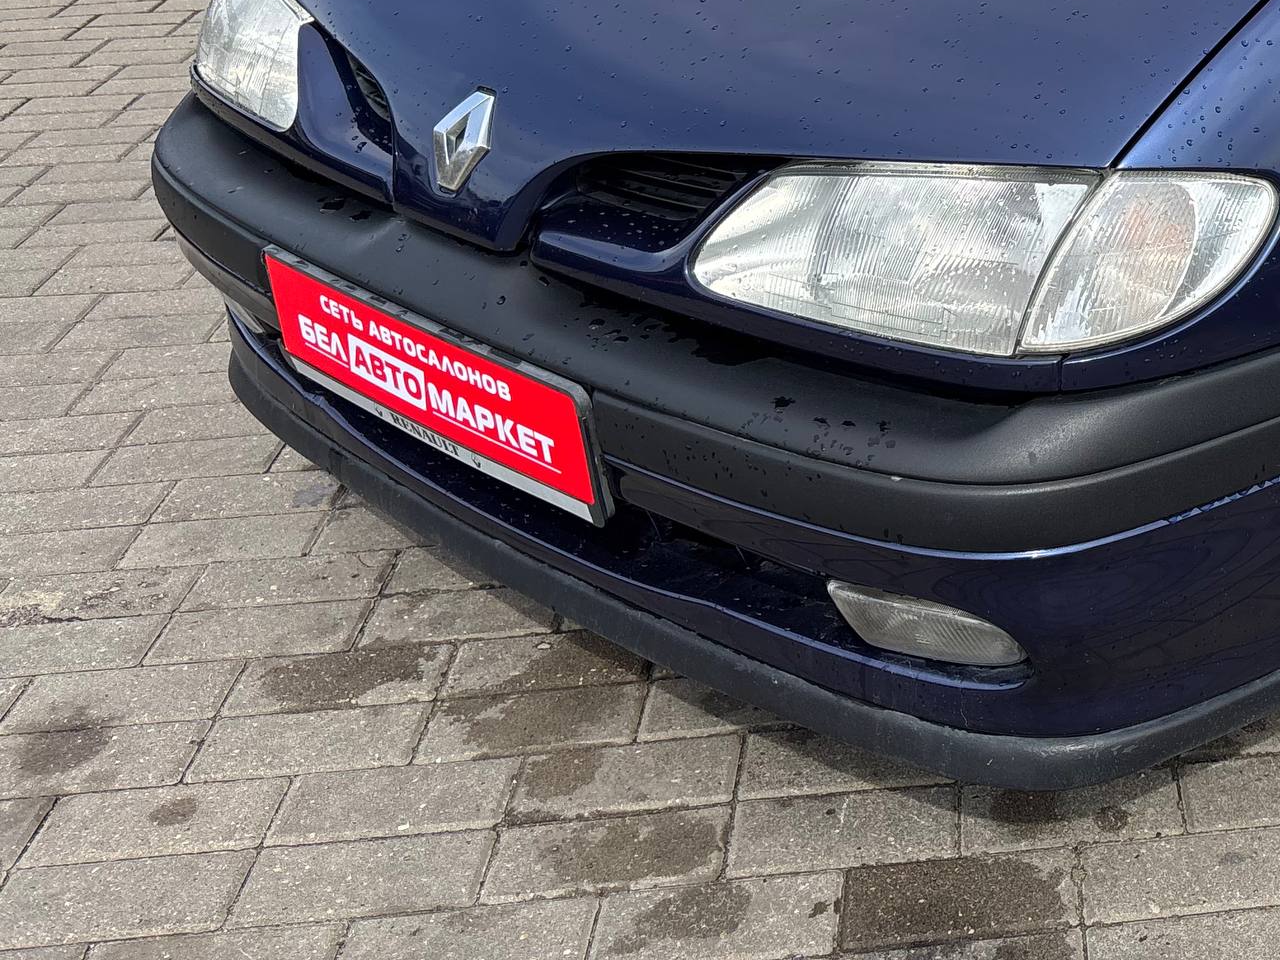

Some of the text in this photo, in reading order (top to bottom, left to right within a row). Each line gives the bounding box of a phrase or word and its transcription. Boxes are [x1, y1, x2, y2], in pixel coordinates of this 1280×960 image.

[319, 294, 512, 401] СЕТЬ АВТОСАЛОНОВ
[389, 412, 460, 457] RENAULT
